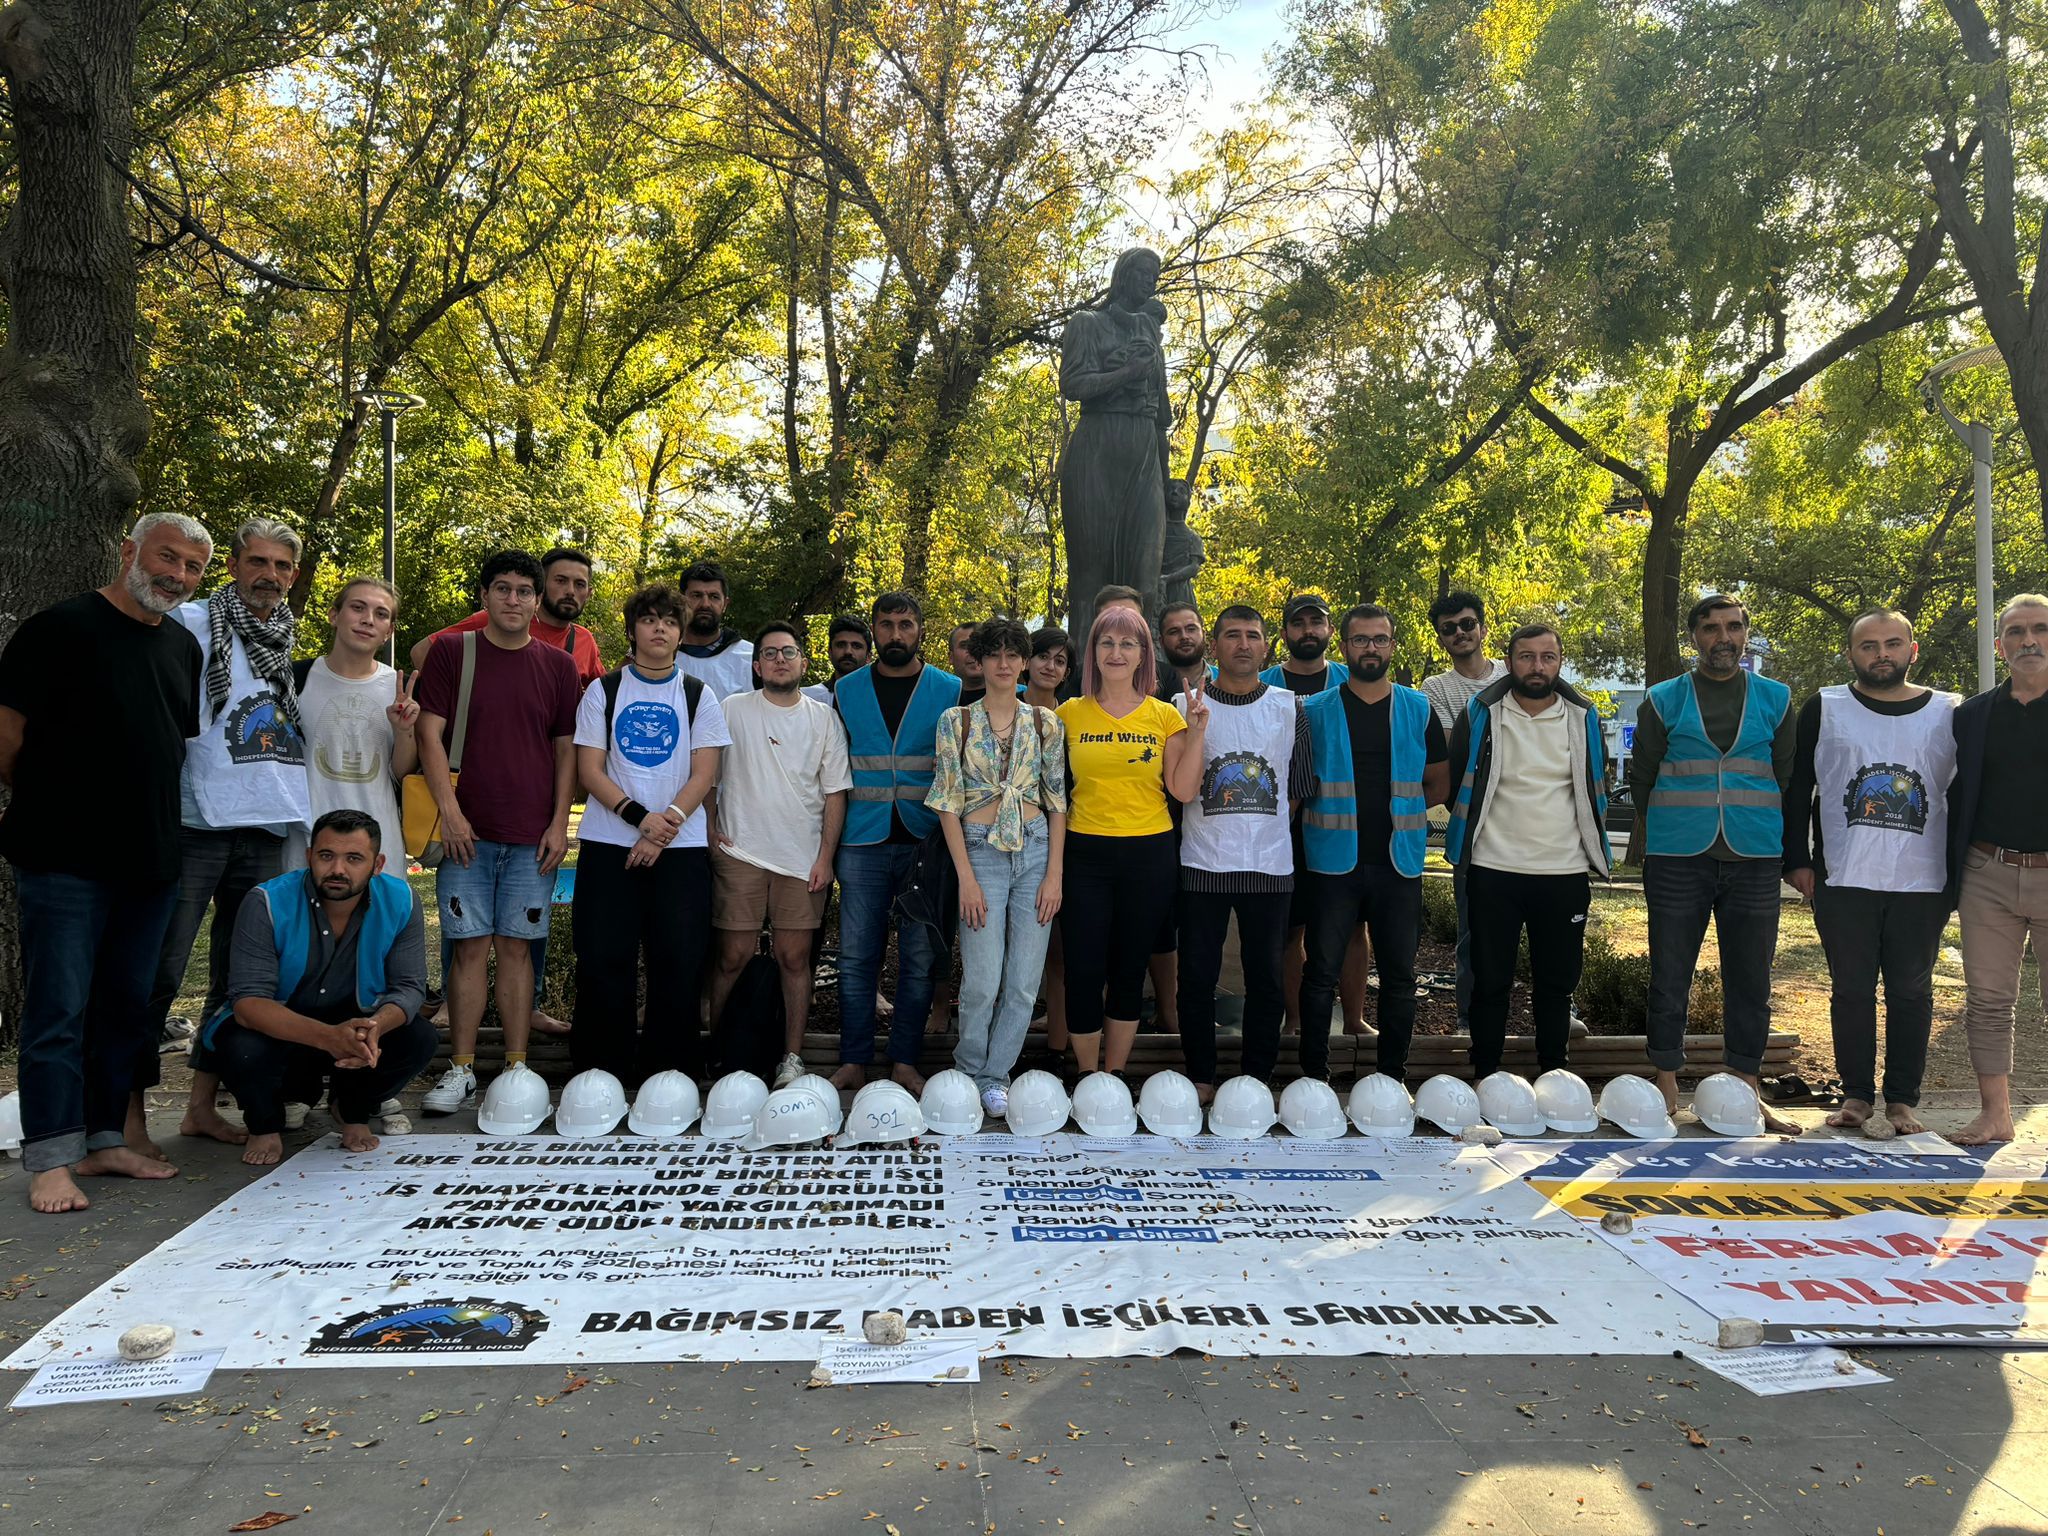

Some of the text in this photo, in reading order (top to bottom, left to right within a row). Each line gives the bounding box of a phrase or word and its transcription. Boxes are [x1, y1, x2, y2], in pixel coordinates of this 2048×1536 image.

[1079, 731, 1158, 746] Head Witch
[235, 753, 278, 762] INDEPENDE
[1862, 769, 1886, 780] MADEN
[1885, 812, 1903, 820] 2018
[1885, 821, 1909, 829] MINERS
[768, 1097, 817, 1119] SOMA
[866, 1109, 905, 1129] 301
[475, 1141, 541, 1152] YÜZ
[545, 1141, 696, 1152] BİNLERCE
[393, 1153, 942, 1167] ÜYE OLDUKLARI İÇİN İŞTEN ATILDI
[715, 1168, 872, 1180] BİNLERCE
[884, 1168, 943, 1181] İŞÇİ
[1008, 1166, 1056, 1178] İşçi
[733, 1182, 944, 1195] ÖLDÜRÜLDÜ
[976, 1177, 1221, 1190] önlemleri alınsın.
[1013, 1187, 1235, 1200] Ücretler Soma
[681, 1199, 945, 1212] YARGILANMADI
[979, 1201, 1342, 1215] ortalamasına getirilsin.
[401, 1215, 550, 1230] AKSİNE
[1017, 1215, 1512, 1229] Banka promosyonları yatırılsın.
[1020, 1225, 1111, 1240] İşten
[1117, 1226, 1217, 1240] atılan
[1222, 1229, 1391, 1242] arkadaşlar
[1401, 1229, 1465, 1242] geri
[381, 1248, 418, 1257] Bu
[729, 1247, 833, 1257] Maddesi
[840, 1245, 951, 1256] kaldırılsın
[1653, 1232, 2004, 1260] FERNAS
[215, 1258, 358, 1271] Sendikalar,
[366, 1259, 429, 1270] Grev
[437, 1261, 467, 1269] ve
[479, 1259, 547, 1270] Toplu
[390, 1269, 438, 1281] İşçi
[449, 1270, 531, 1283] sağlığı
[539, 1273, 569, 1281] ve
[392, 1302, 447, 1316] MADEN
[579, 1298, 1560, 1332] BAĞIMSIZ ADEN İŞÇİLERİ SENDİKASI
[421, 1337, 462, 1345] 2018
[312, 1343, 525, 1353] INDEPENDENT MINERS UNION
[138, 1354, 204, 1367] TROLLERİ
[833, 1360, 892, 1369] KOYMAYI
[50, 1365, 169, 1381] VARSA BİZİM DE
[35, 1379, 183, 1395] OYUNCAKLARI VAR.
